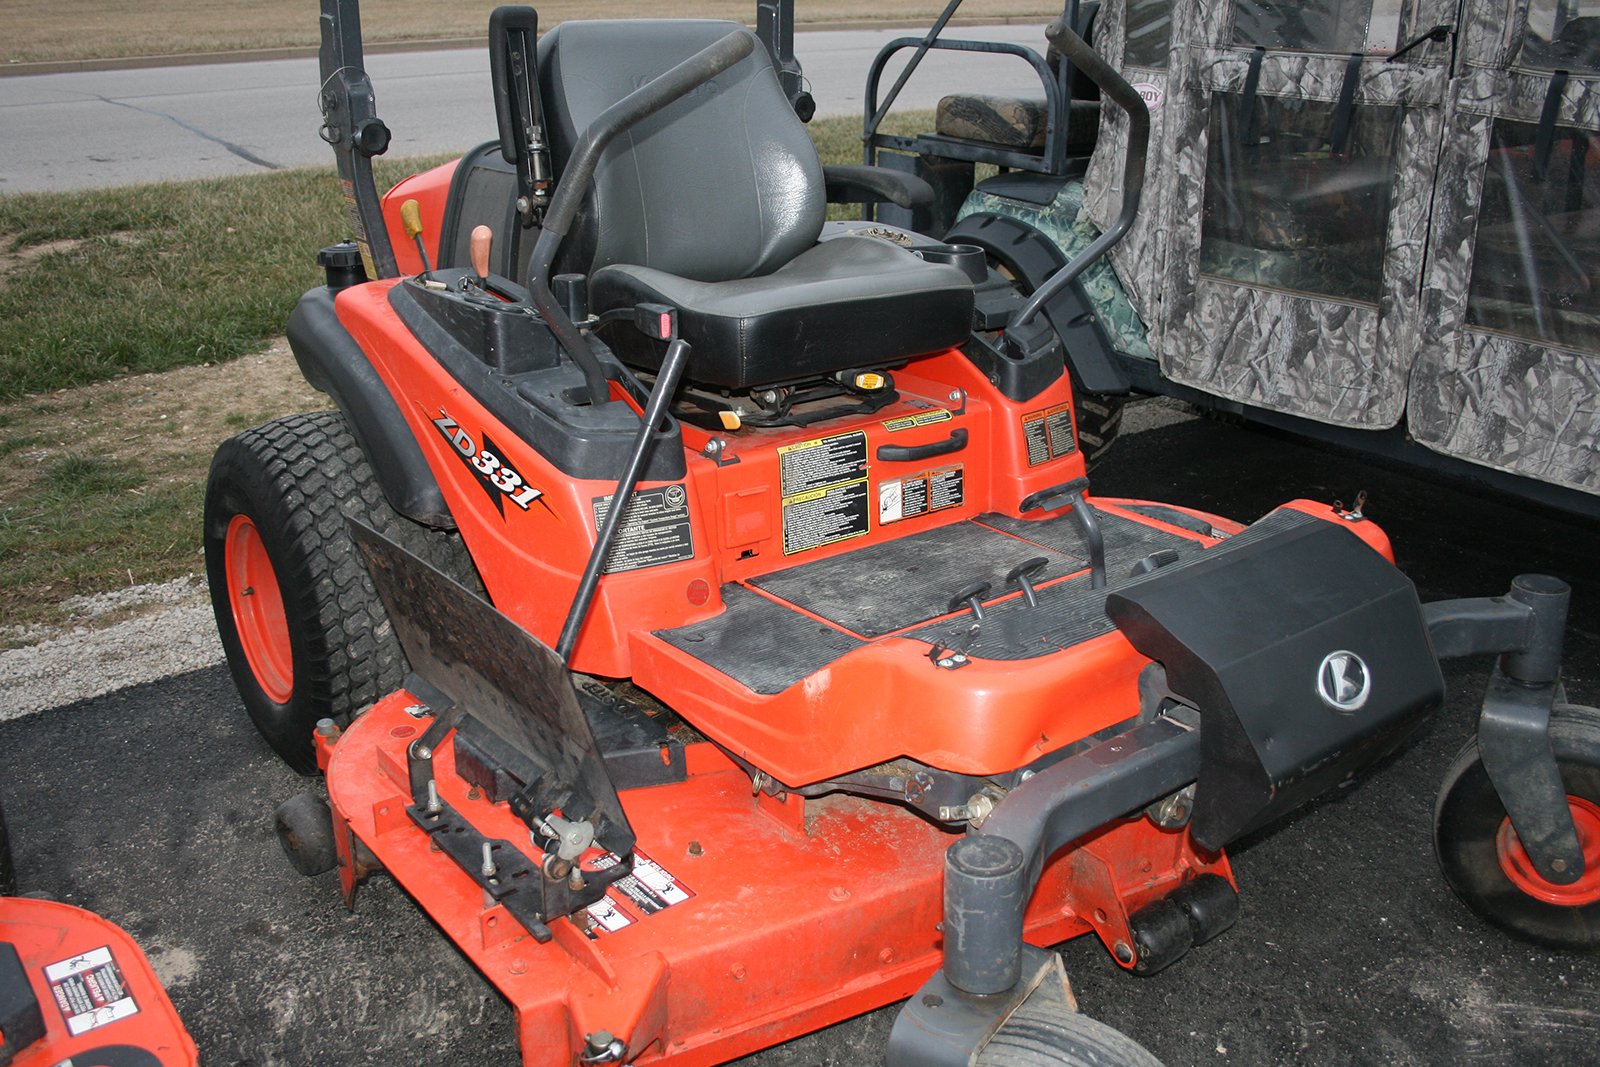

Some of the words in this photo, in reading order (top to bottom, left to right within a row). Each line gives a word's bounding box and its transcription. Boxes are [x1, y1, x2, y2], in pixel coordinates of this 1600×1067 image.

[432, 408, 543, 510] ZD331
[53, 985, 69, 1007] DANGER
[86, 974, 102, 998] PELIGRO
